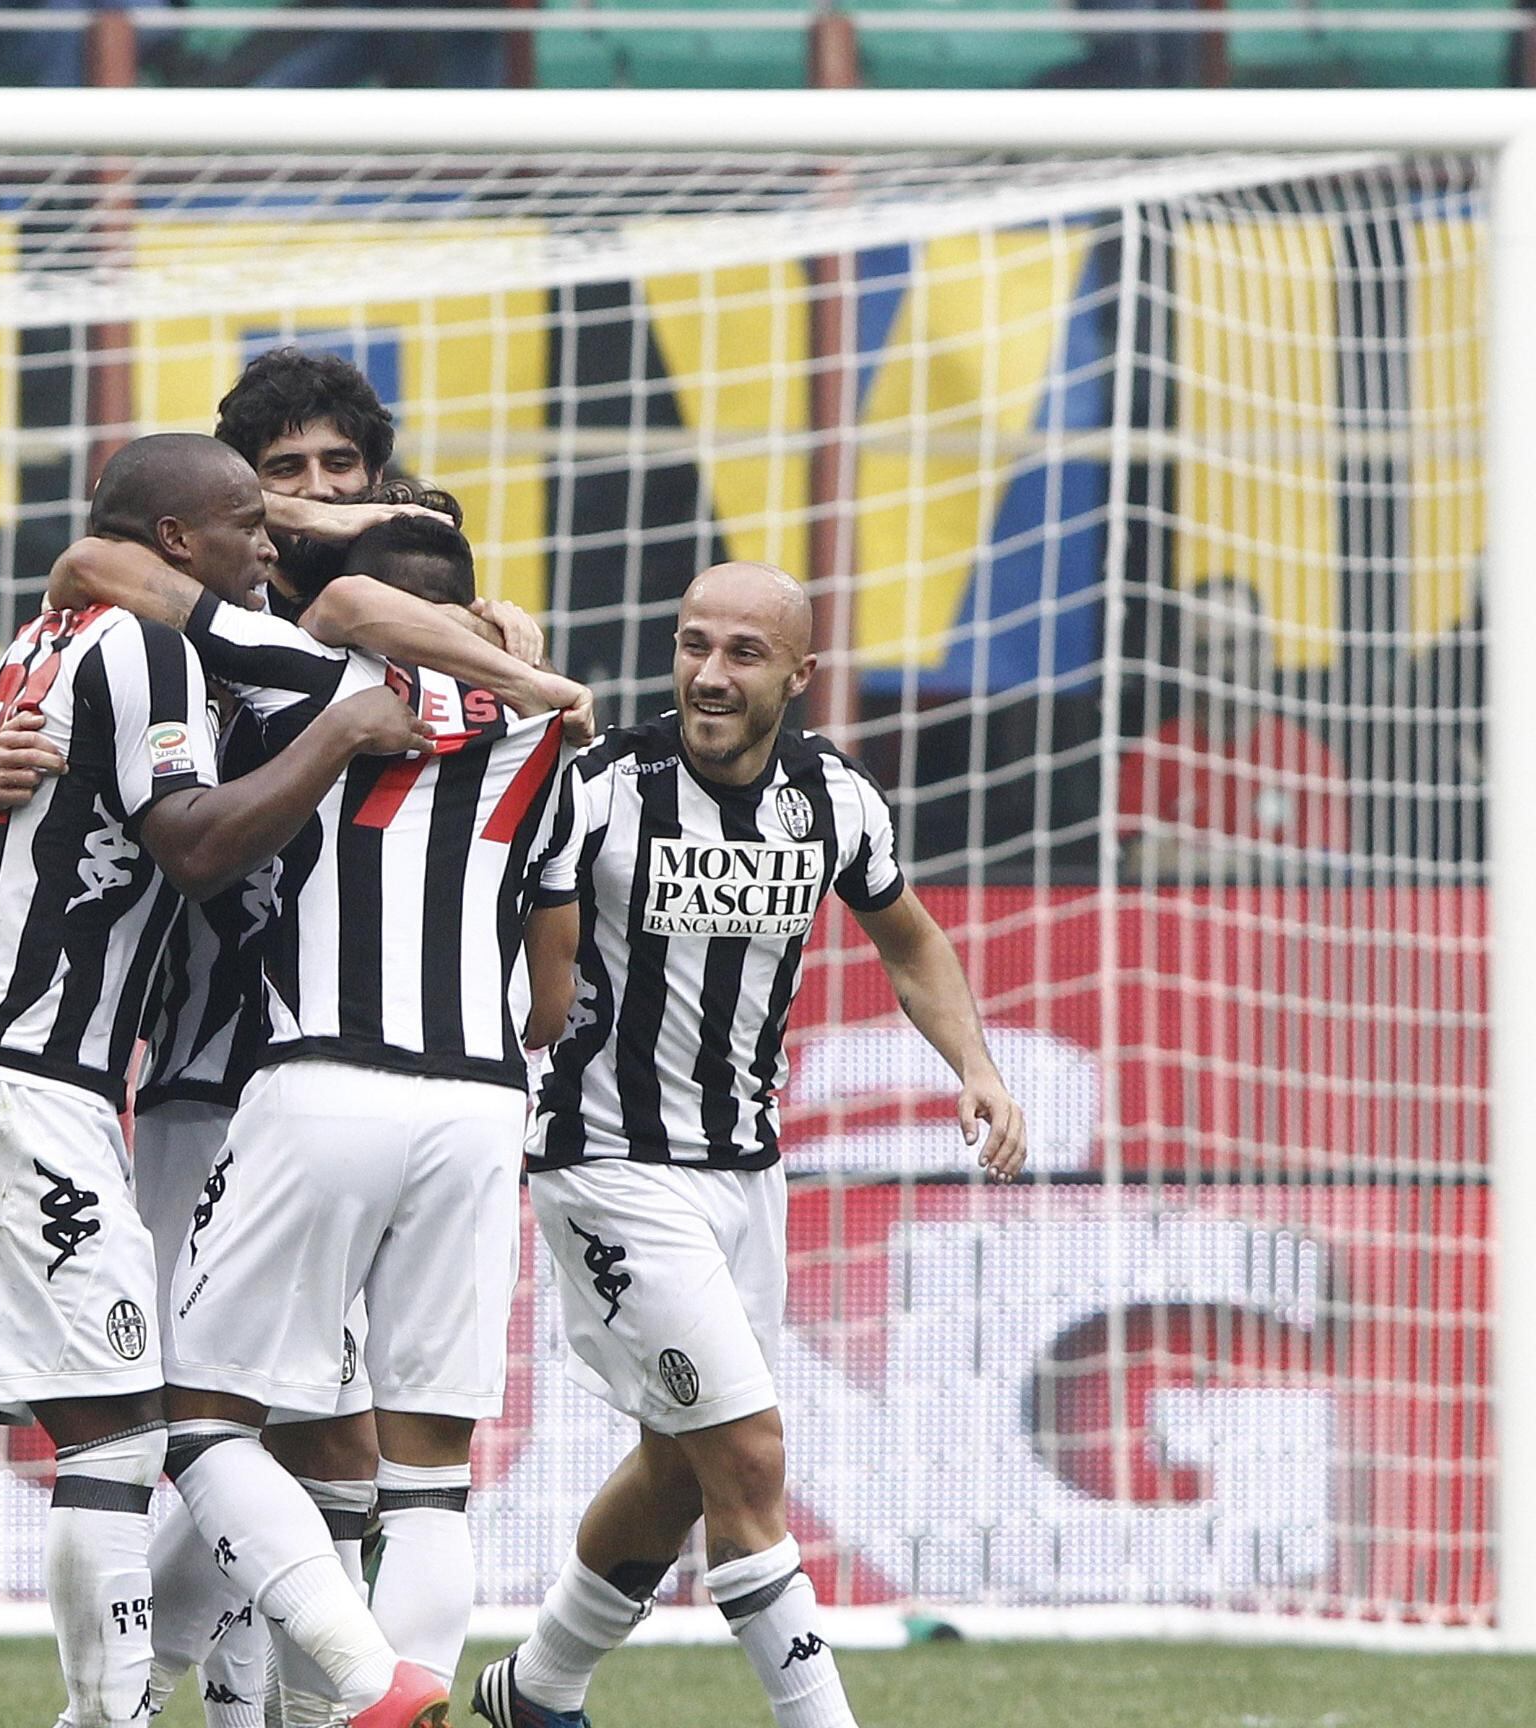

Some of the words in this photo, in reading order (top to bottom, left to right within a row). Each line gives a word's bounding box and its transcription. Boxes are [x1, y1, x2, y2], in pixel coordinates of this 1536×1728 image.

[655, 845, 818, 881] MONTE
[651, 881, 815, 916] PASCHI
[648, 915, 719, 933] BANCA
[727, 919, 768, 934] DAL
[775, 918, 808, 934] 1472
[178, 1273, 209, 1320] Kappa
